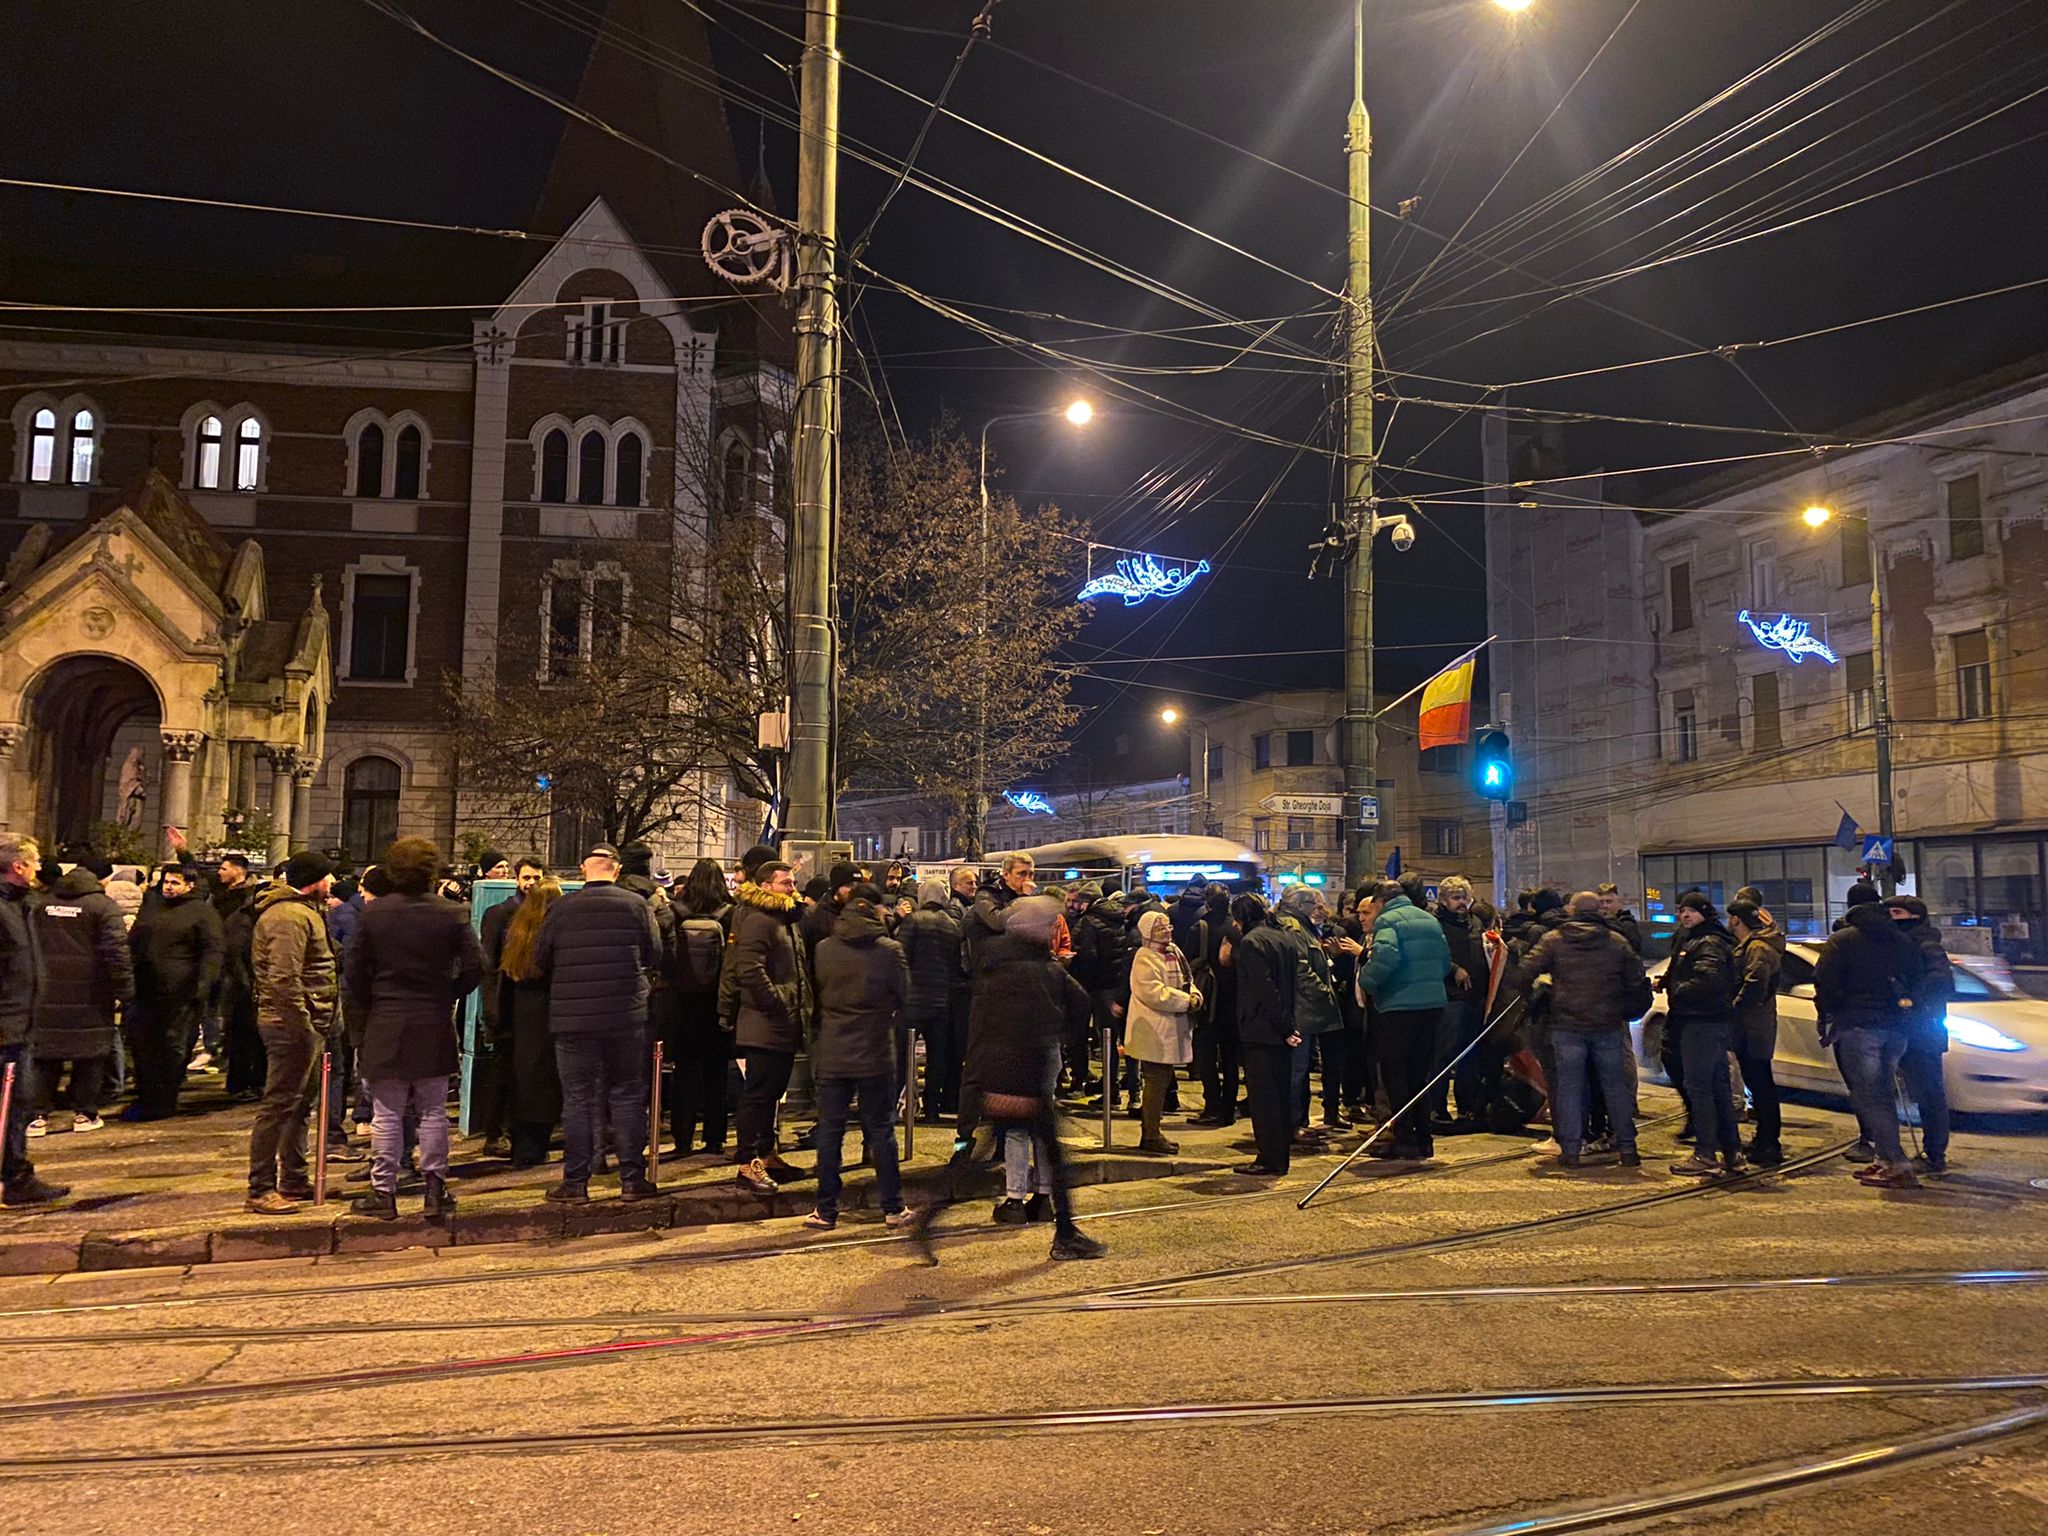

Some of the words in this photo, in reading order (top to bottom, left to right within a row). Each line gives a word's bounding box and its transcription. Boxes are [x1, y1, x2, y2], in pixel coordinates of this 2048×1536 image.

[1282, 800, 1291, 809] Str.
[1292, 800, 1318, 812] Gheorghe
[1319, 800, 1331, 812] Doja
